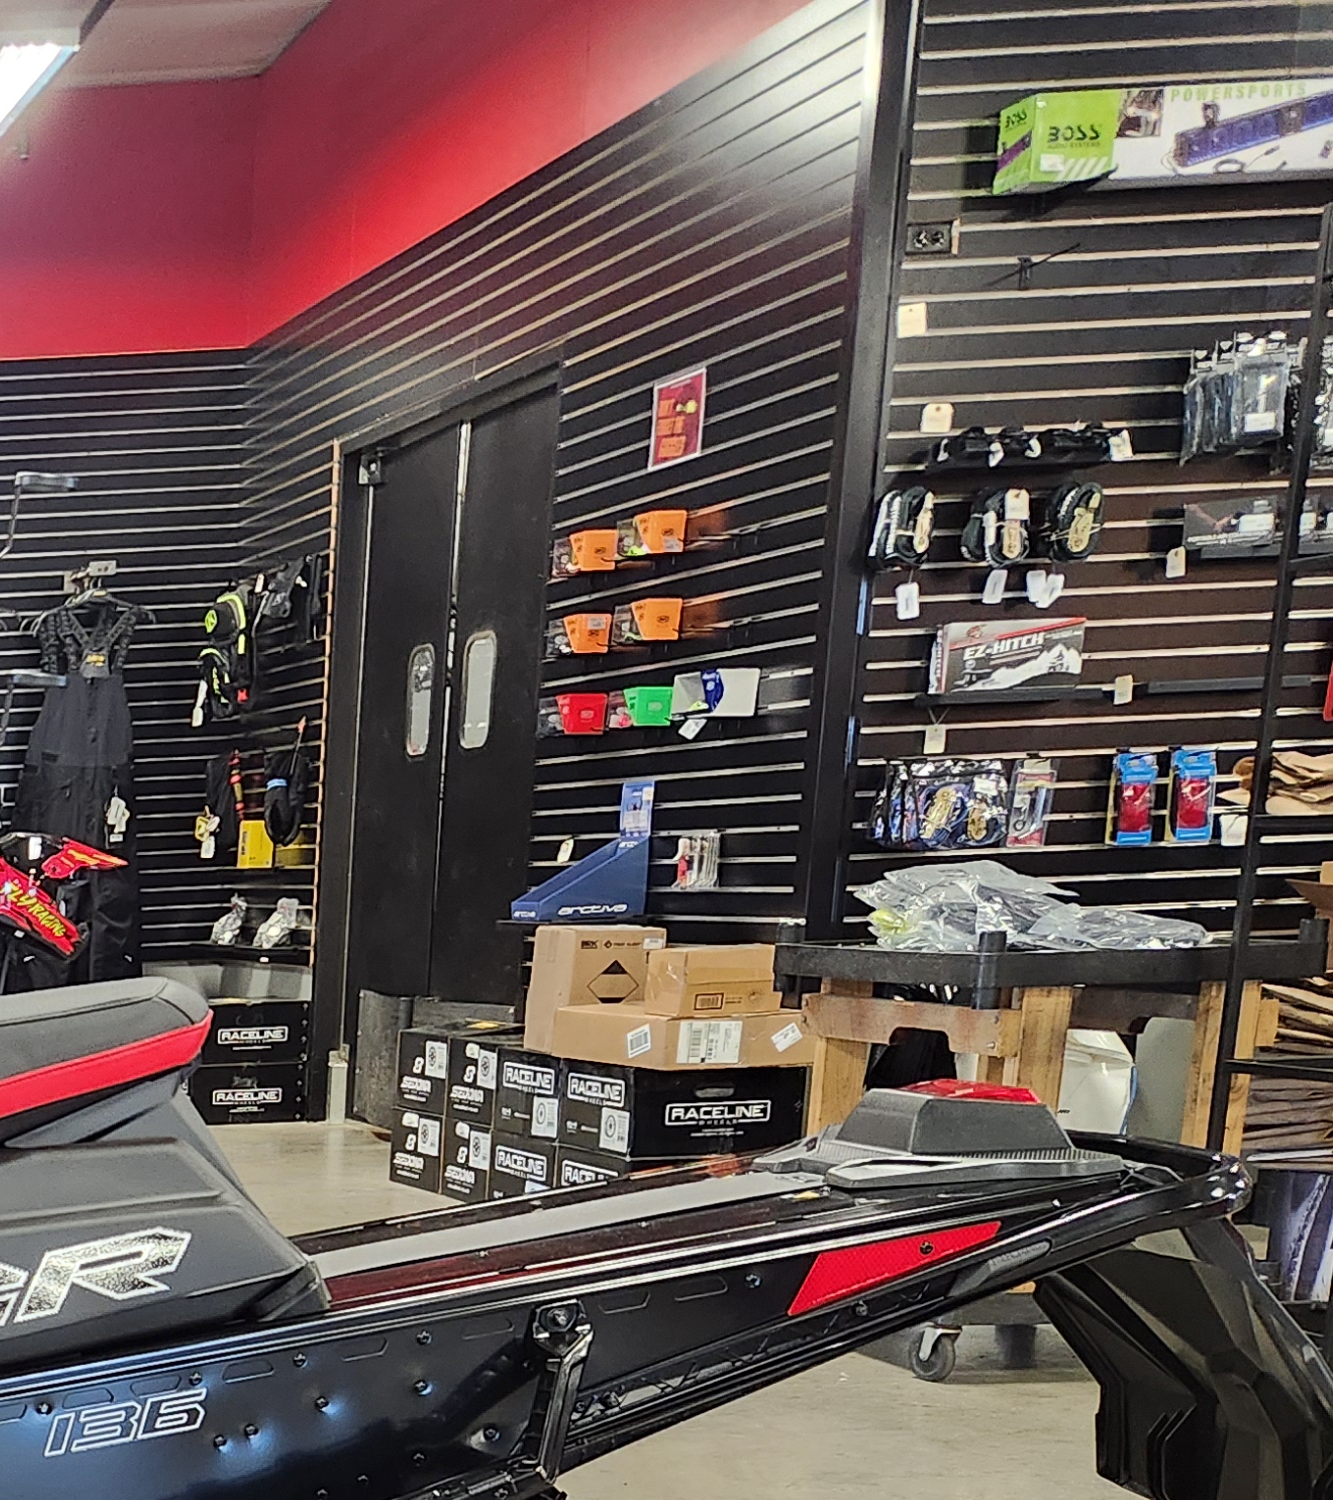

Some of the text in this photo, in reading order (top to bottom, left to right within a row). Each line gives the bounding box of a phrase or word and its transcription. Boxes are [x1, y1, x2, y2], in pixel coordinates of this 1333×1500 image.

[1171, 82, 1306, 102] POWERSPORTS
[1048, 124, 1101, 141] BOSS
[962, 631, 1046, 661] EZ-HITCH
[558, 903, 628, 916] arctiva
[220, 1028, 284, 1042] RACELINE
[505, 1066, 554, 1089] RACELINE
[215, 1089, 279, 1102] RACELINE
[570, 1079, 623, 1101] RACELINE
[670, 1103, 767, 1121] RACELINE
[496, 1151, 545, 1177] RACELINE
[43, 1387, 208, 1458] 136
